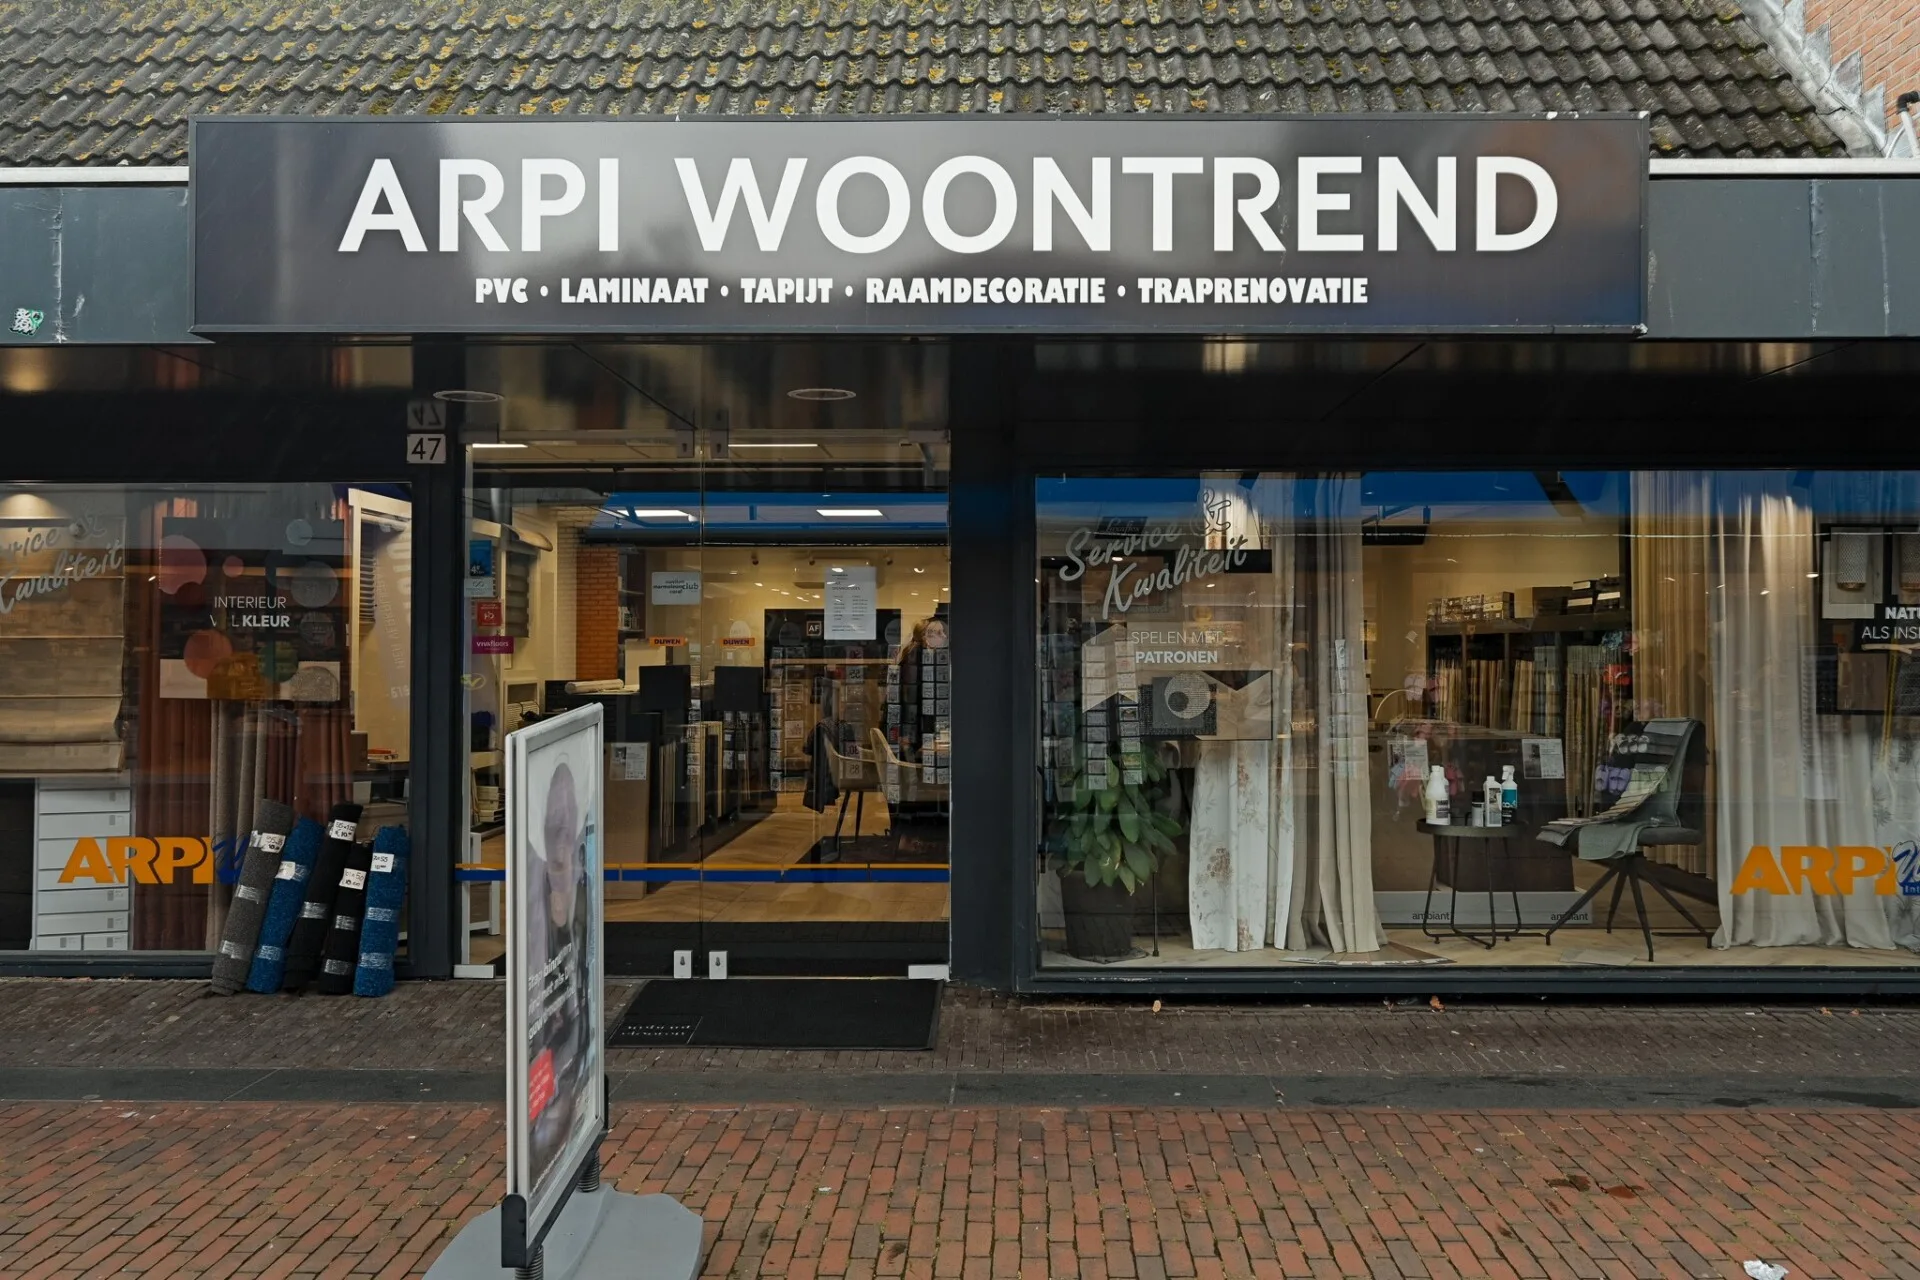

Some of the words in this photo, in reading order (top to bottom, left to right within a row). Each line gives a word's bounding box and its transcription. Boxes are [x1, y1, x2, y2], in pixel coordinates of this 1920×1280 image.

[338, 157, 619, 252] ARPI
[674, 155, 1559, 254] WOONTREND
[475, 277, 529, 304] PVC
[561, 277, 709, 304] LAMINAAT
[741, 277, 833, 304] TAPIJT
[866, 277, 1106, 304] RAAMDECORATIE
[1138, 277, 1369, 304] TRAPRENOVATIE
[411, 437, 442, 461] 47
[1059, 520, 1183, 582] Service
[1190, 486, 1232, 536] &
[1102, 534, 1249, 620] Kwaliteit
[214, 596, 287, 609] INTERIEUR
[1884, 606, 1920, 620] NAT
[210, 614, 240, 628] VL
[242, 614, 291, 628] KLEUR
[808, 624, 820, 632] AF
[1131, 631, 1187, 644] SPELEN
[1191, 631, 1223, 644] MET
[1861, 626, 1890, 640] ALS
[1894, 626, 1920, 640] INS
[1135, 650, 1218, 664] PATRONEN
[57, 836, 213, 884] ARPI
[1729, 845, 1898, 896] ARPI
[1550, 911, 1589, 921] aiant
